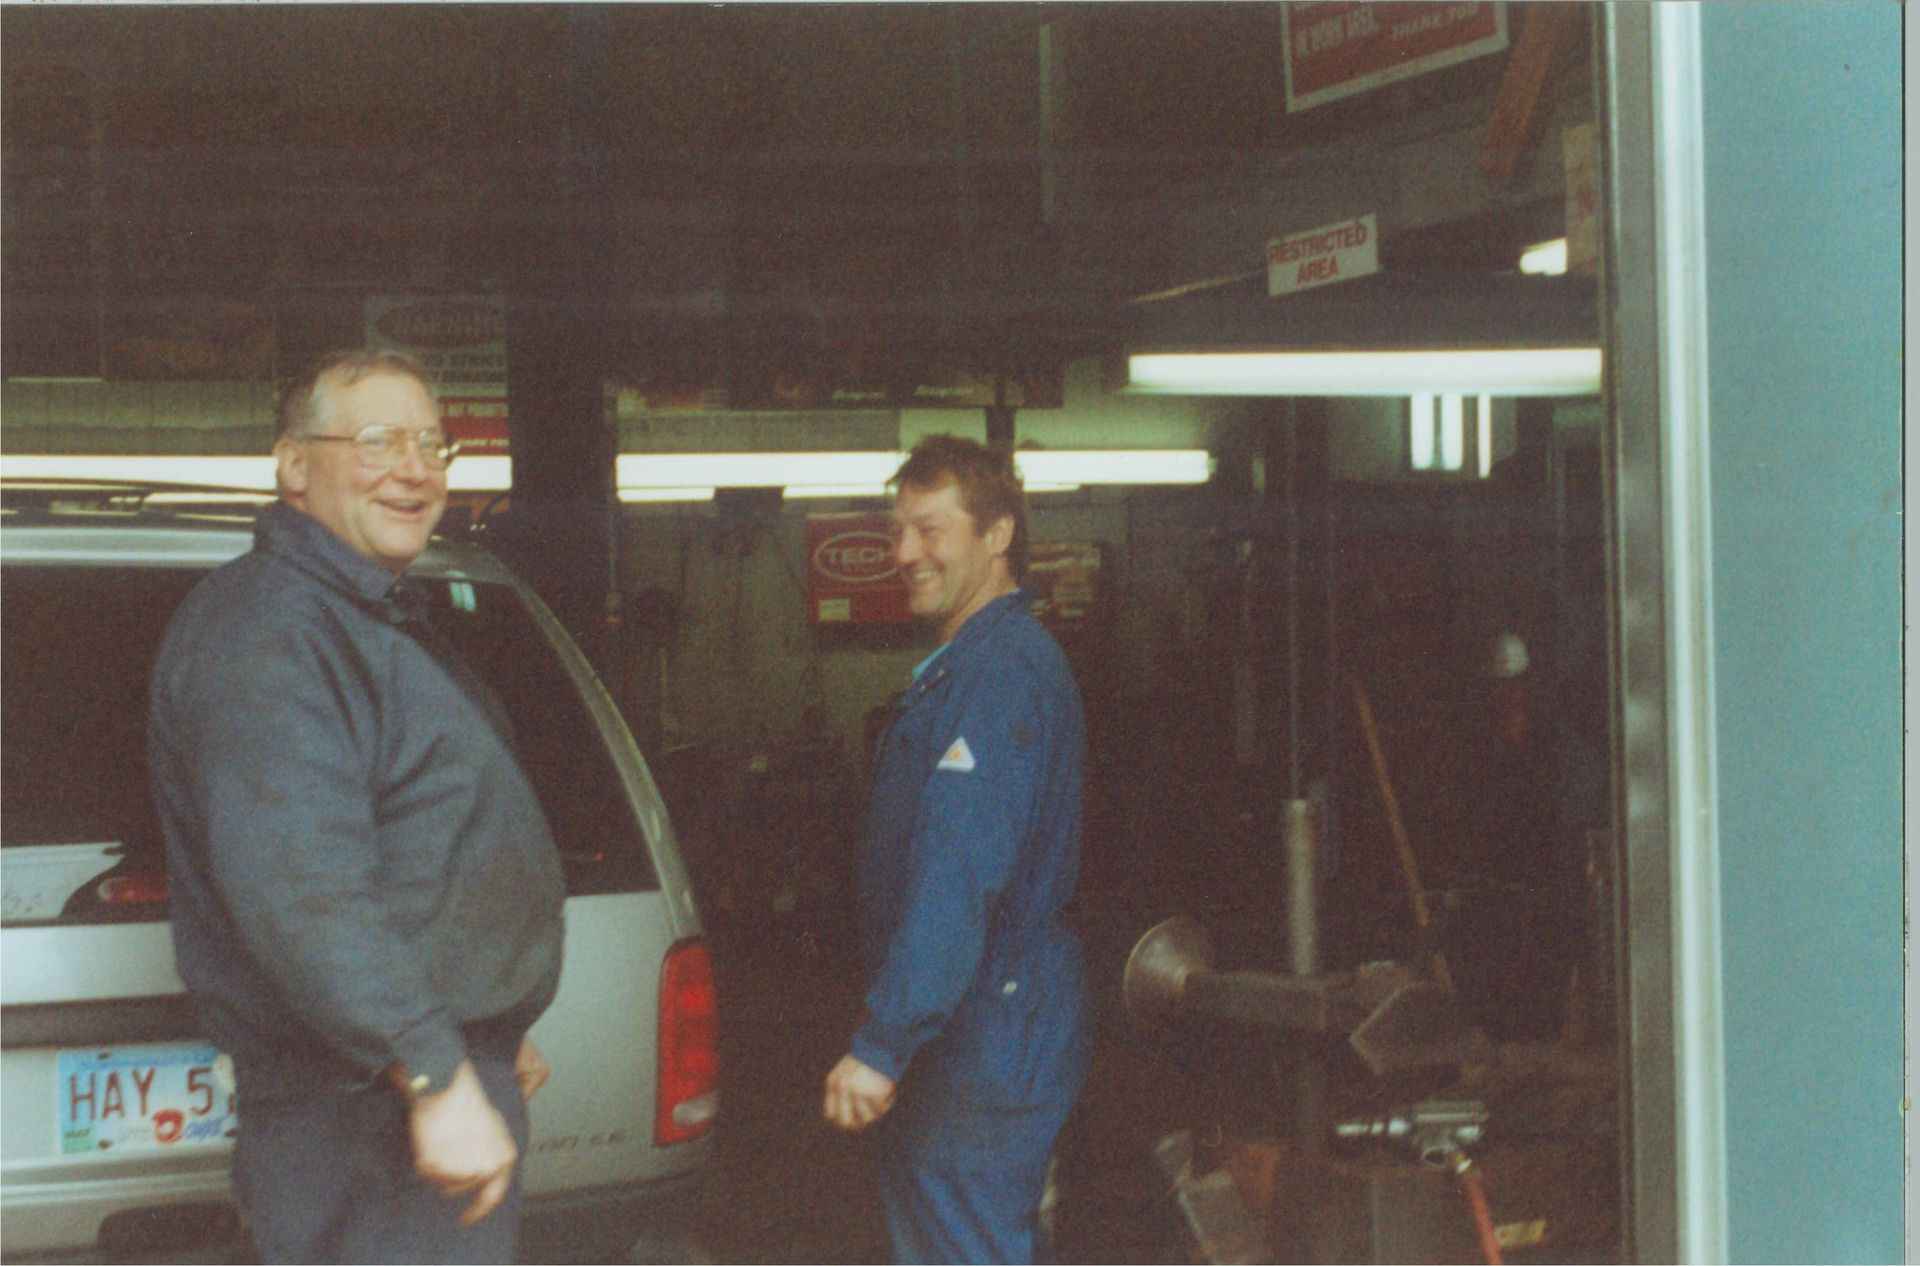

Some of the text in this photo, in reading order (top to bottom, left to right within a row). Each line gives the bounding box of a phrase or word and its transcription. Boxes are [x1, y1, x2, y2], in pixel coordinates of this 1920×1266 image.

[1268, 222, 1368, 262] RESTRICTED
[1296, 256, 1340, 285] AREA
[69, 1066, 156, 1123] HAY
